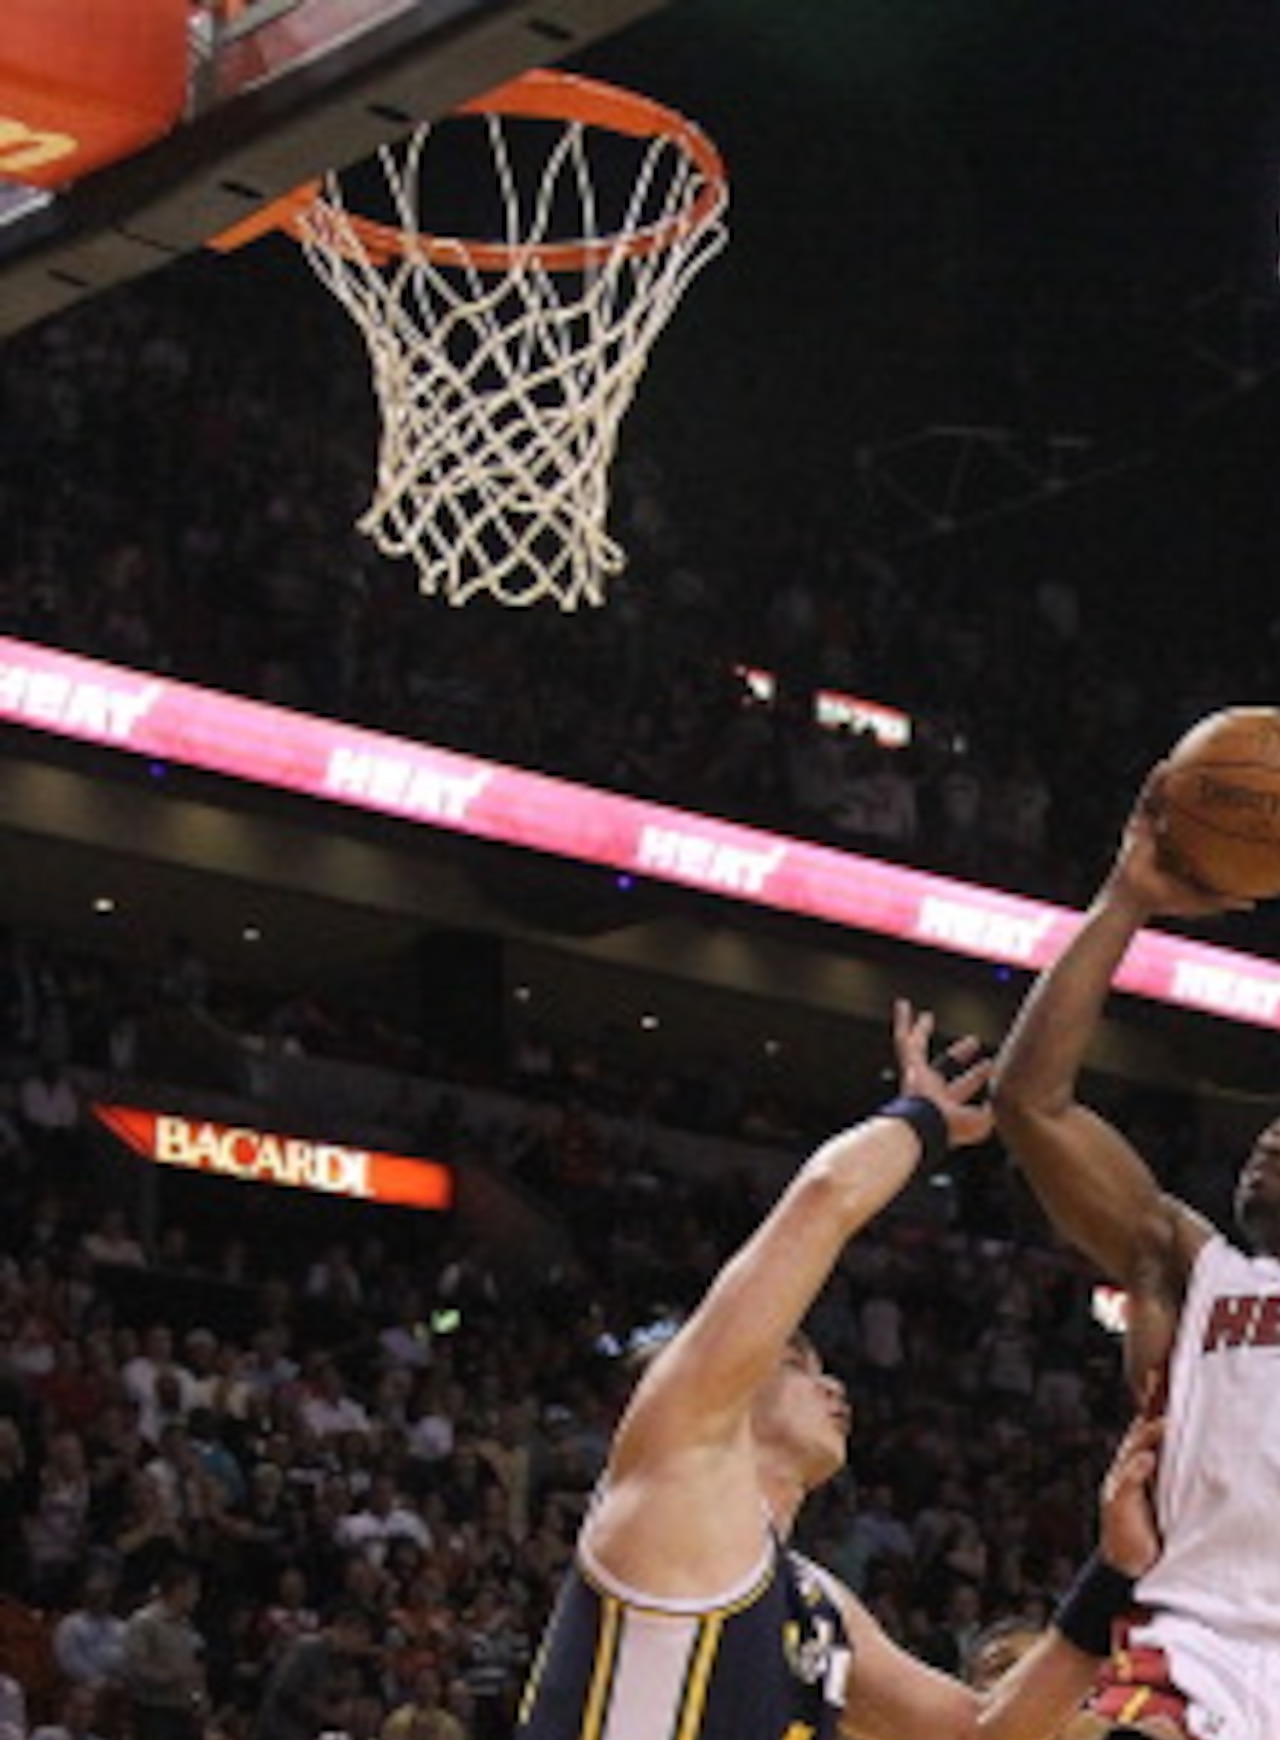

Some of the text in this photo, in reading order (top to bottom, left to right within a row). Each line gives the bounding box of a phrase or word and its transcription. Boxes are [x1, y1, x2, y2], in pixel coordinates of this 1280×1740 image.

[325, 747, 493, 819] HEAT
[635, 824, 787, 892] HEAT
[917, 896, 1056, 957] HEAT
[154, 1114, 376, 1199] BACARDI
